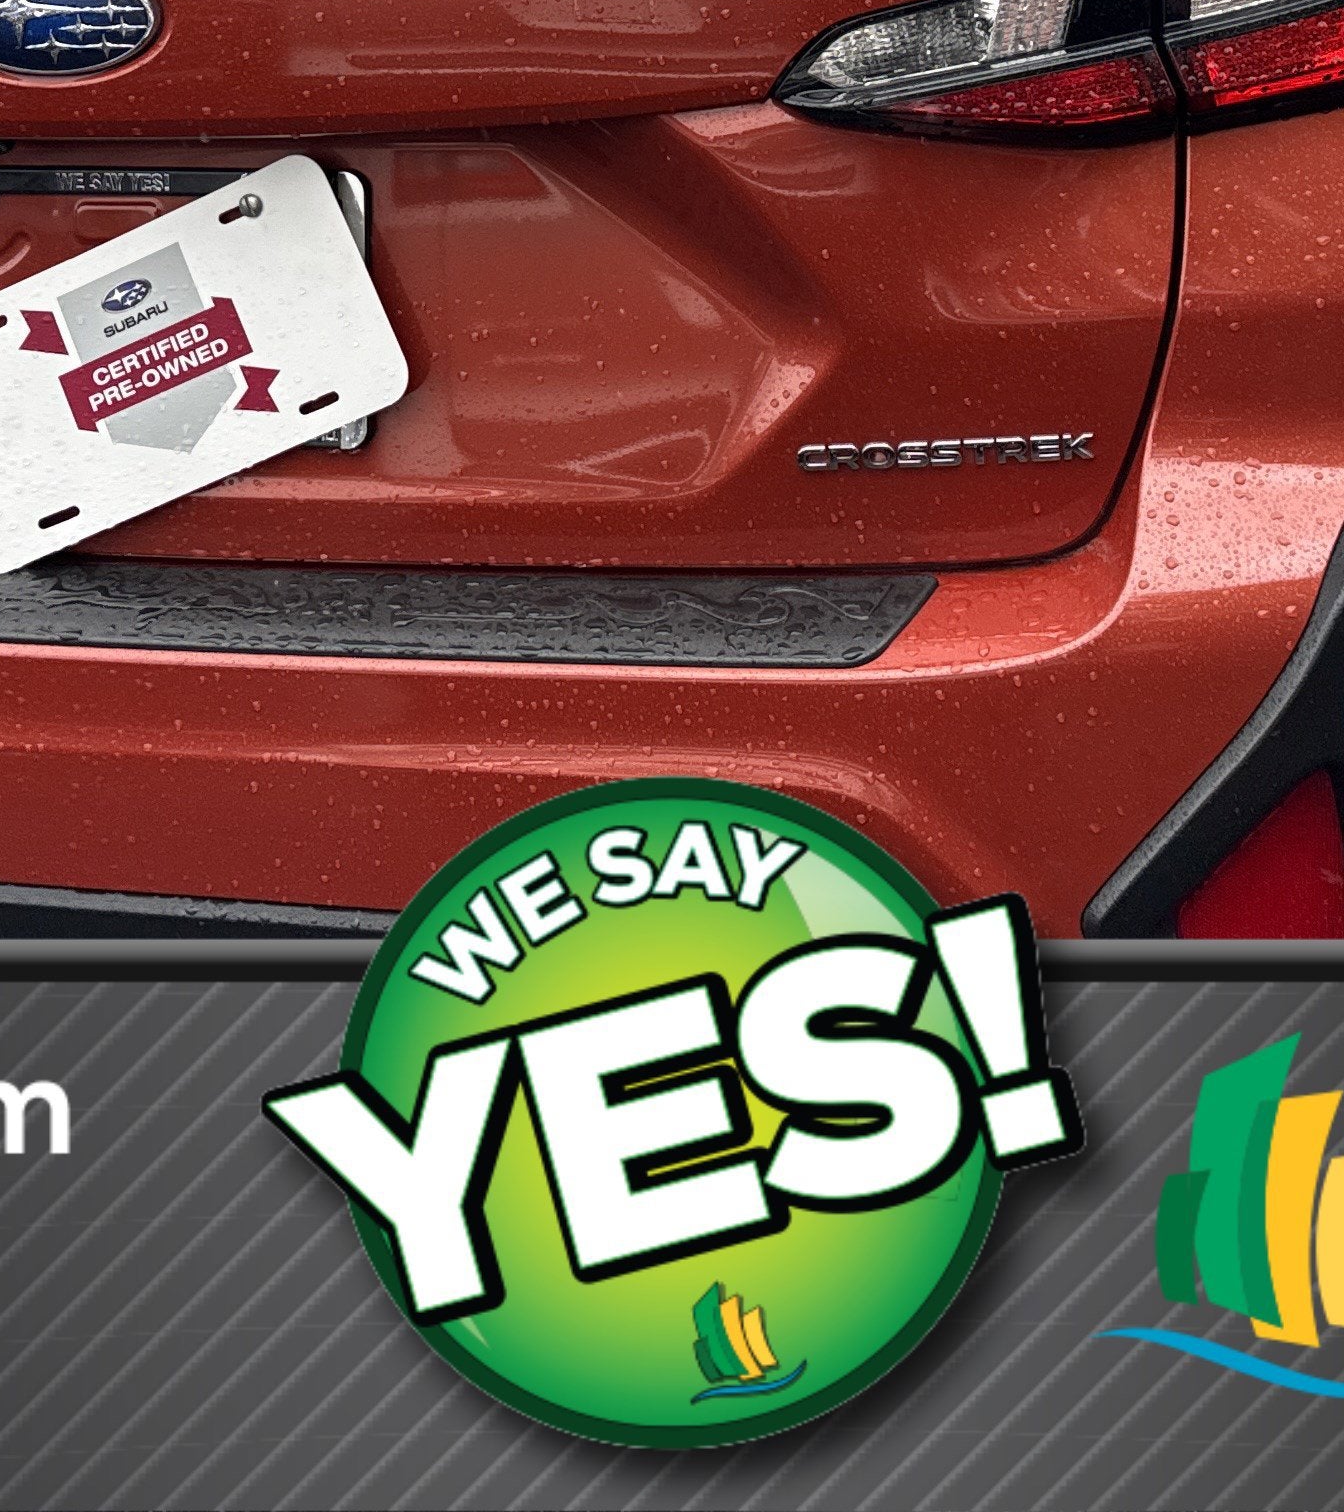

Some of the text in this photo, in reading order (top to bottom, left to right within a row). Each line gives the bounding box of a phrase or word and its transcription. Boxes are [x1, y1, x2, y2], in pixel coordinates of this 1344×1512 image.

[56, 172, 170, 192] WE SAY YES!
[103, 300, 169, 338] SUBARU
[92, 322, 209, 386] CERTIFIED
[87, 337, 229, 412] PRE-OWNED
[796, 433, 1095, 471] CROSSTREK
